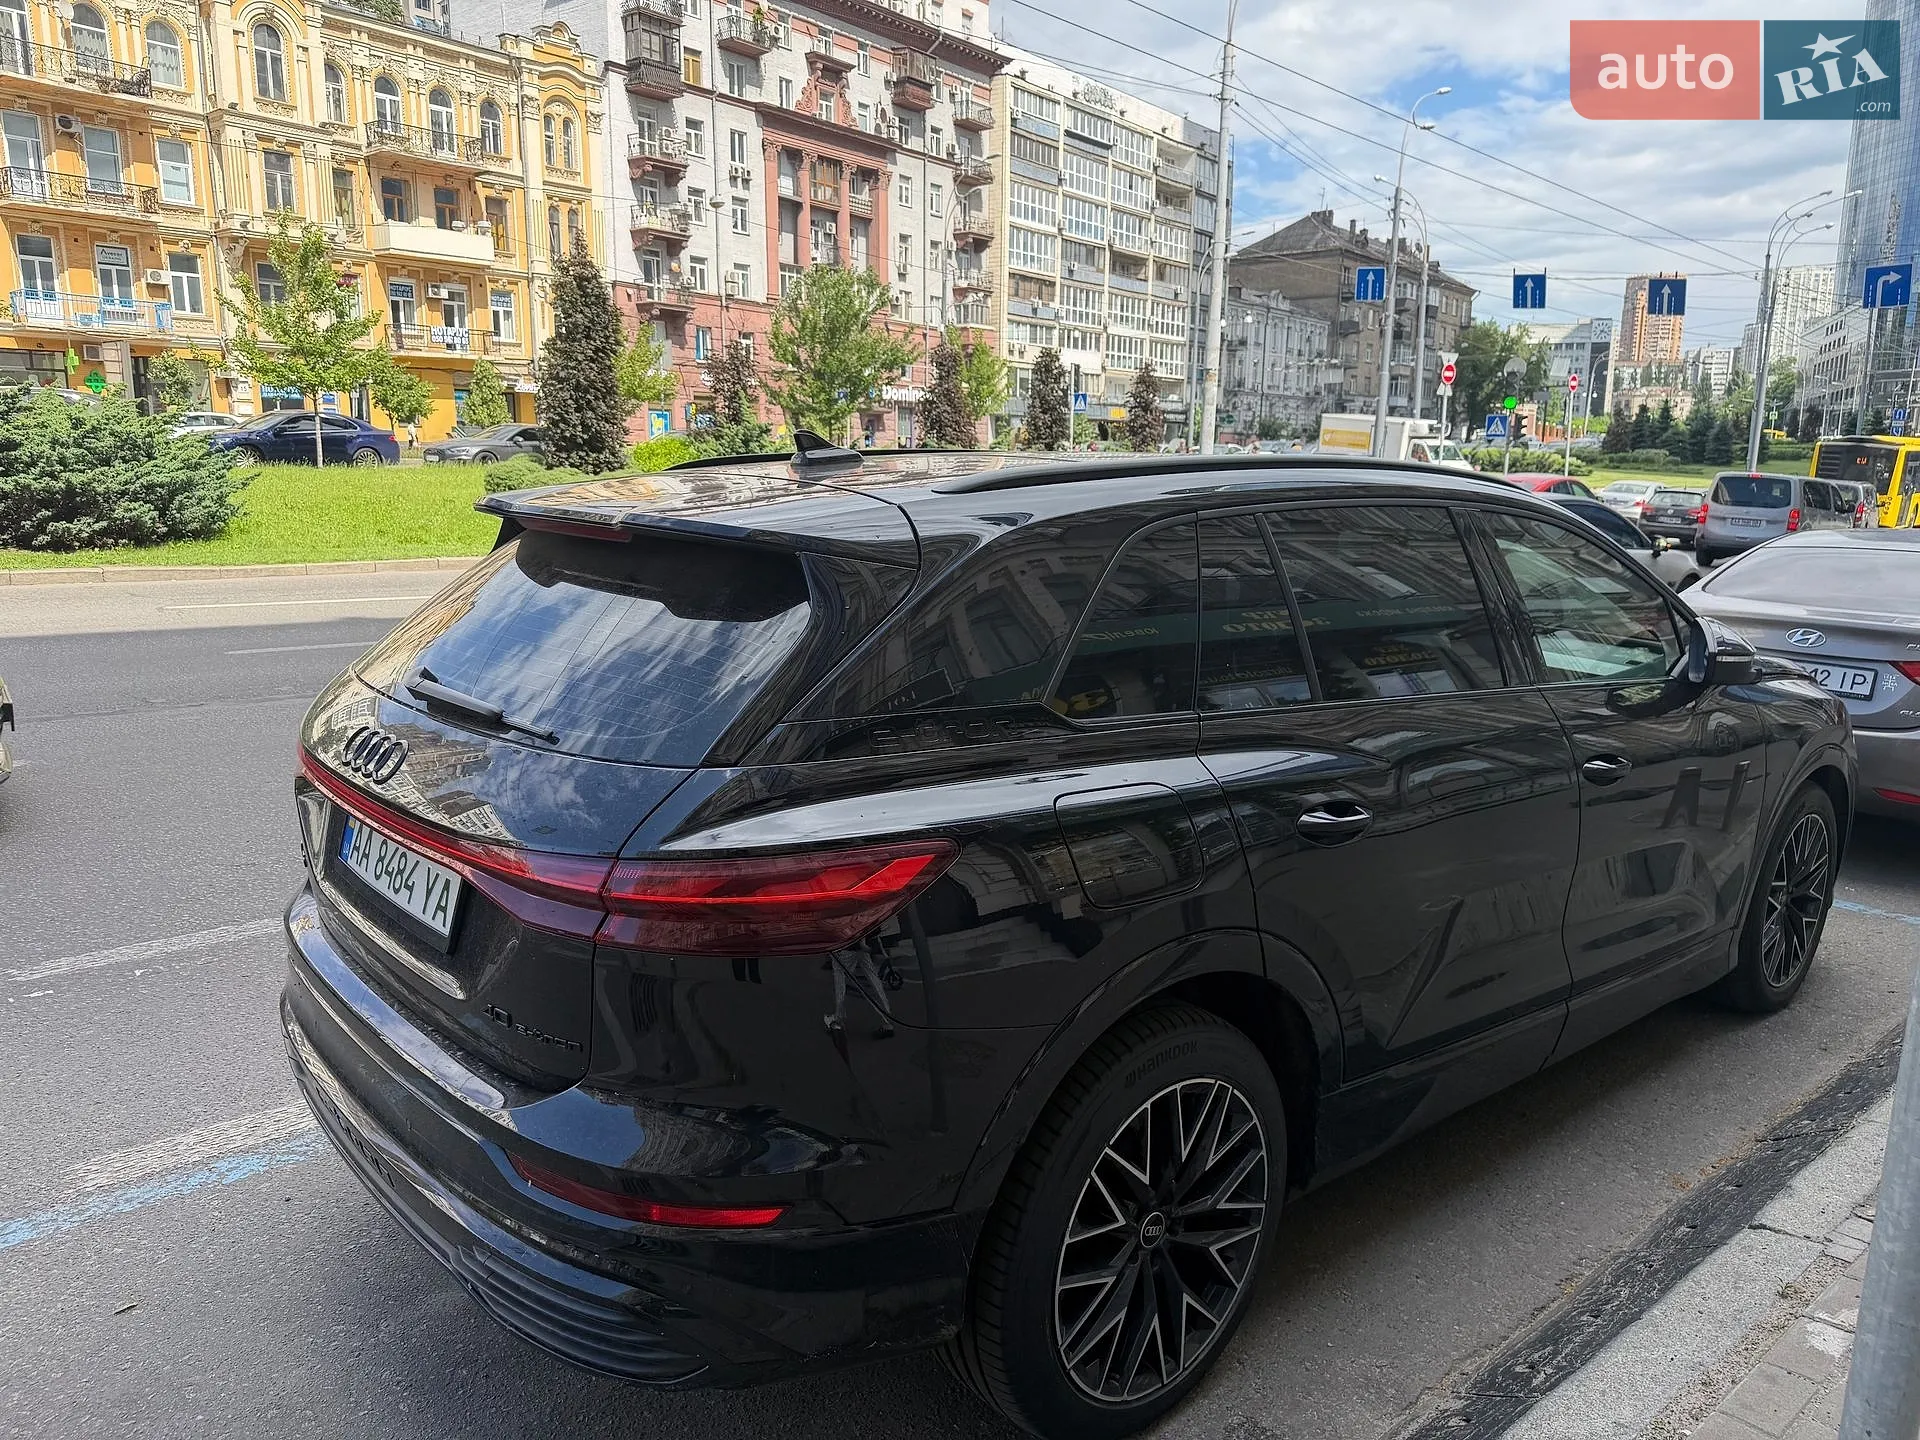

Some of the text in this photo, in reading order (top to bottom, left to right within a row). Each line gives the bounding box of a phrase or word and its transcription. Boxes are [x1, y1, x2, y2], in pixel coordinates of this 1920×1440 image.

[431, 326, 469, 338] НОТАРІУС
[881, 384, 928, 402] Domin
[1808, 667, 1832, 688] 12
[1840, 671, 1867, 690] IP
[350, 822, 452, 930] AA 8484 YA
